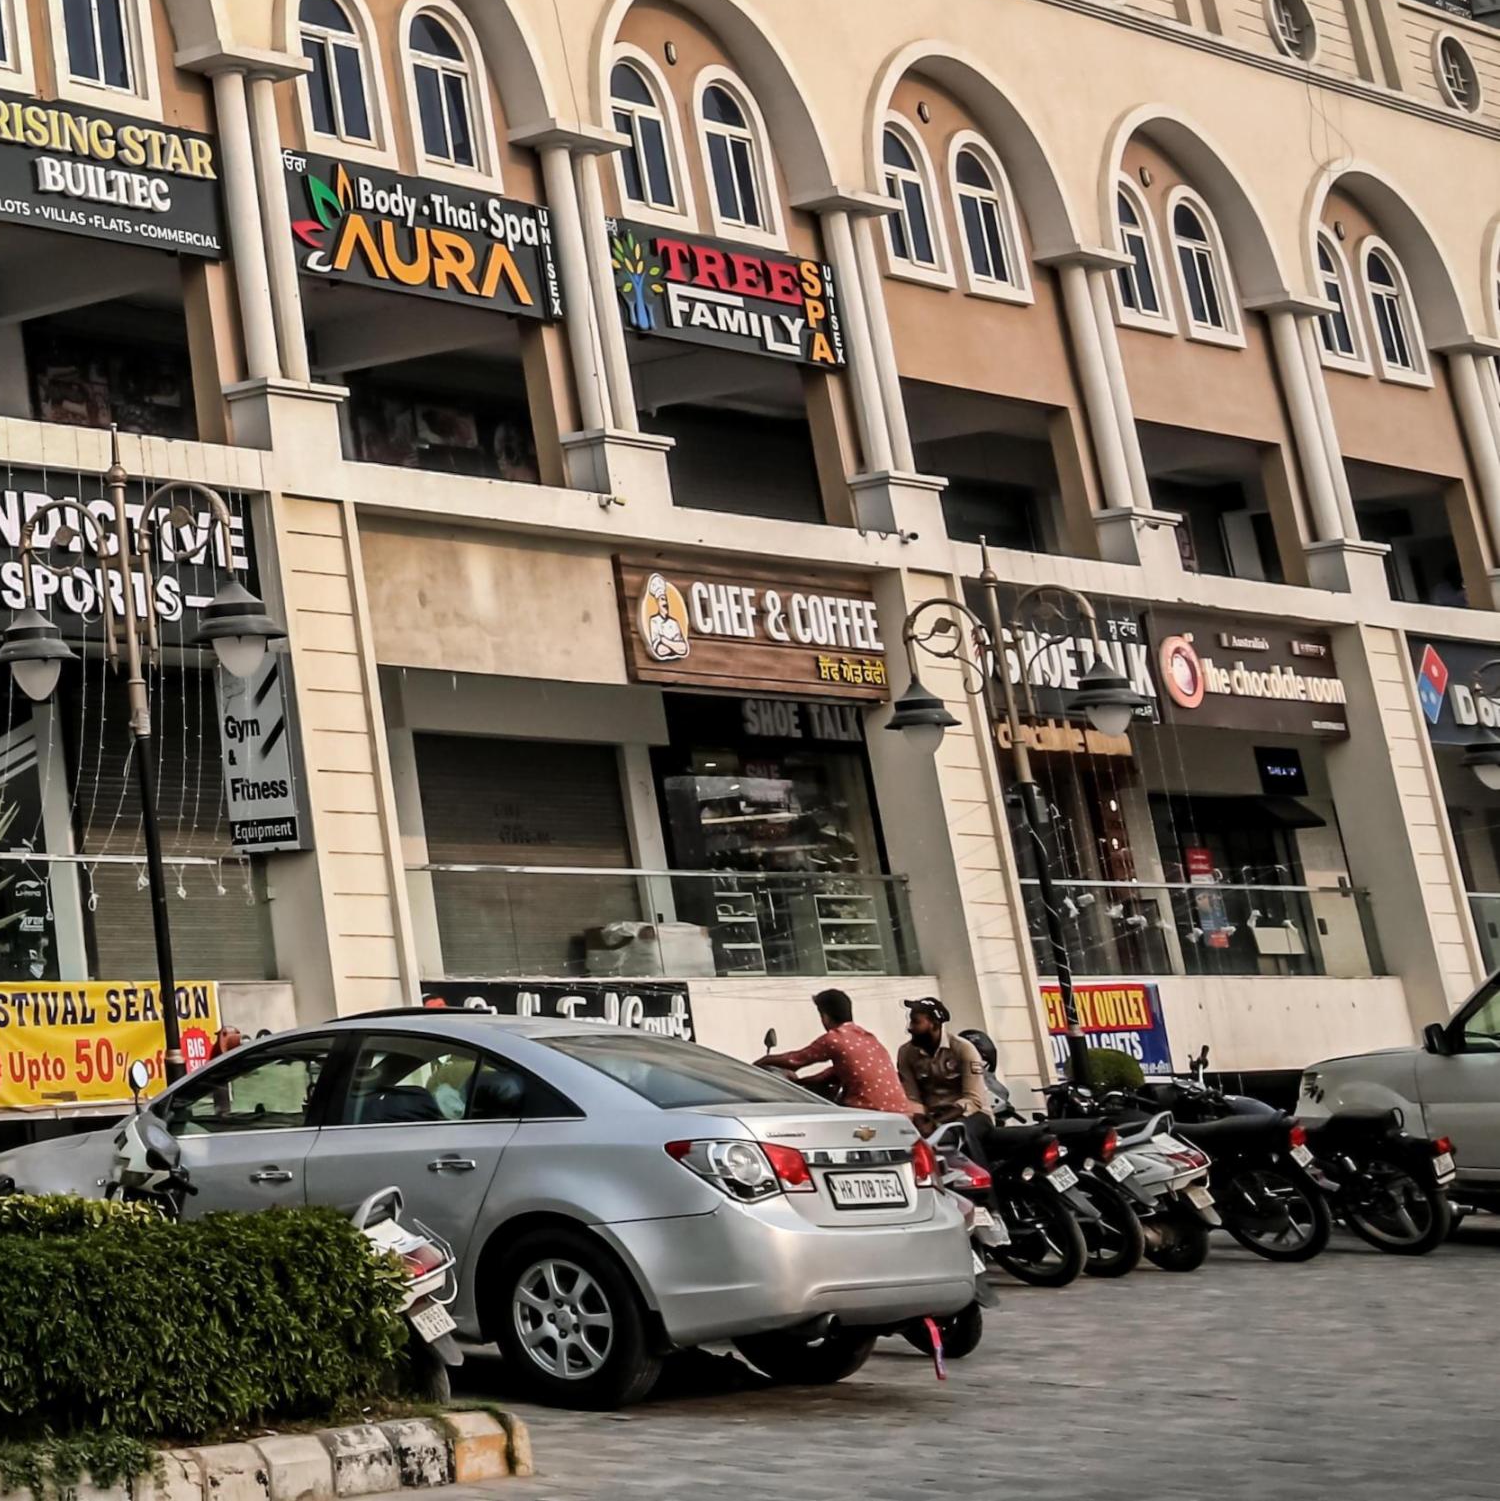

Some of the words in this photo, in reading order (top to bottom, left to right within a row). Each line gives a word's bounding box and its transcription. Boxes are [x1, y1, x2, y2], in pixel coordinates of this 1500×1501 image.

[117, 127, 218, 181] STAR
[34, 155, 172, 213] BUILTEC
[356, 176, 418, 230] Body
[430, 194, 479, 233] Thai
[488, 199, 540, 252] Spa
[139, 222, 221, 251] COMMERCIAL
[332, 213, 534, 306] AURA
[537, 208, 564, 317] UNISEX
[655, 237, 803, 305] TREE
[665, 283, 806, 355] FAMILY
[800, 260, 837, 365] SPA
[821, 264, 845, 365] UNISEX
[687, 580, 757, 638] CHEF
[763, 589, 791, 642] &
[787, 592, 885, 651] COFFEE
[1200, 657, 1232, 695] the
[1231, 660, 1307, 700] chocolate
[1304, 676, 1347, 705] room
[741, 699, 804, 739] SHOE
[808, 703, 864, 742] TALK
[1452, 684, 1500, 728] Do
[224, 715, 261, 748] Gym
[227, 748, 238, 767] &
[231, 776, 288, 803] Fitness
[234, 820, 293, 844] Equipment
[106, 986, 210, 1023] SEAON
[1042, 990, 1094, 1029] CTRY
[1093, 990, 1149, 1026] OUTLET
[186, 1037, 206, 1058] BIG
[8, 1051, 66, 1089] Upto
[839, 1180, 855, 1200] HR
